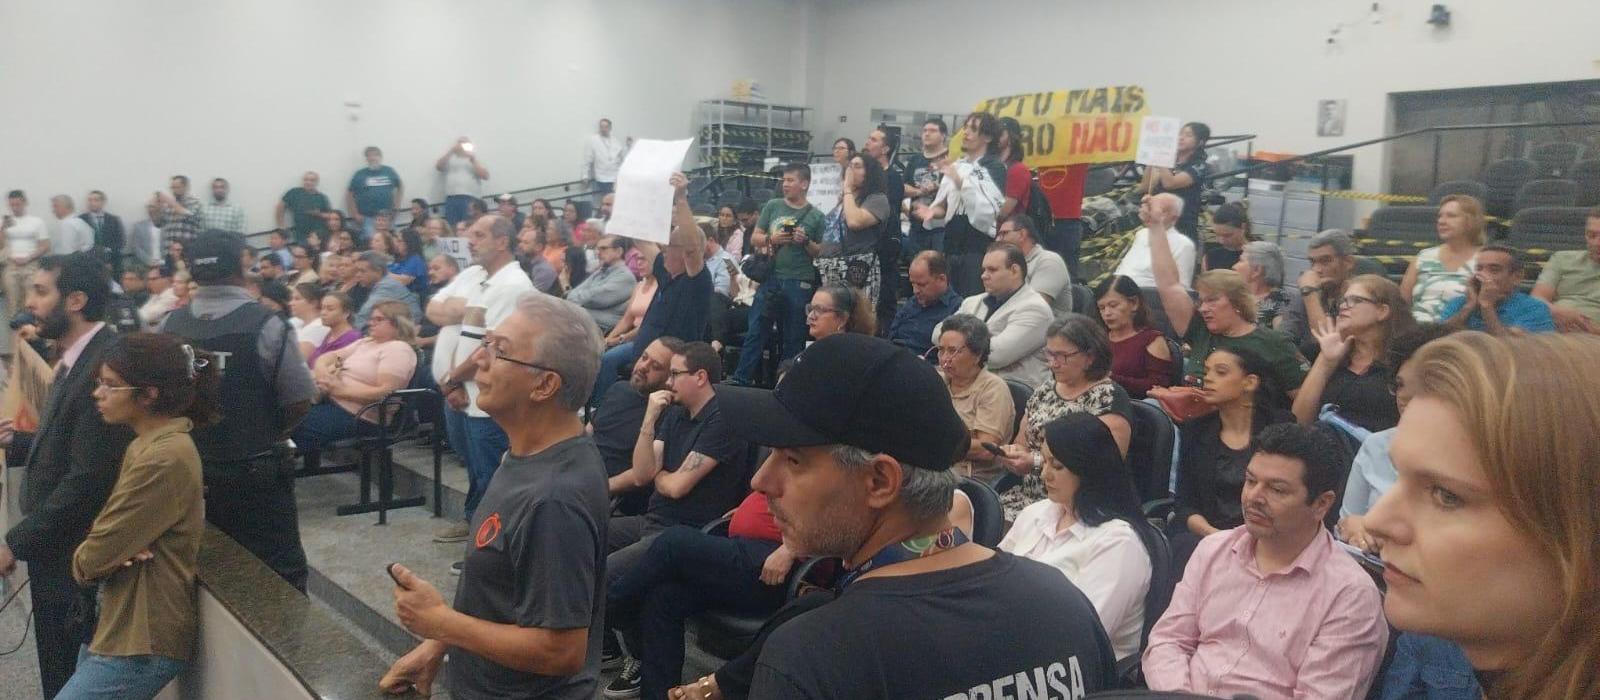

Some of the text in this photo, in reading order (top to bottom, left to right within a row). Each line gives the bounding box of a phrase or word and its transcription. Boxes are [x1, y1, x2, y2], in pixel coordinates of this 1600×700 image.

[986, 86, 1144, 117] IPTU MAIS
[1019, 115, 1133, 156] RO NÃO
[943, 655, 1085, 700] ENSA
